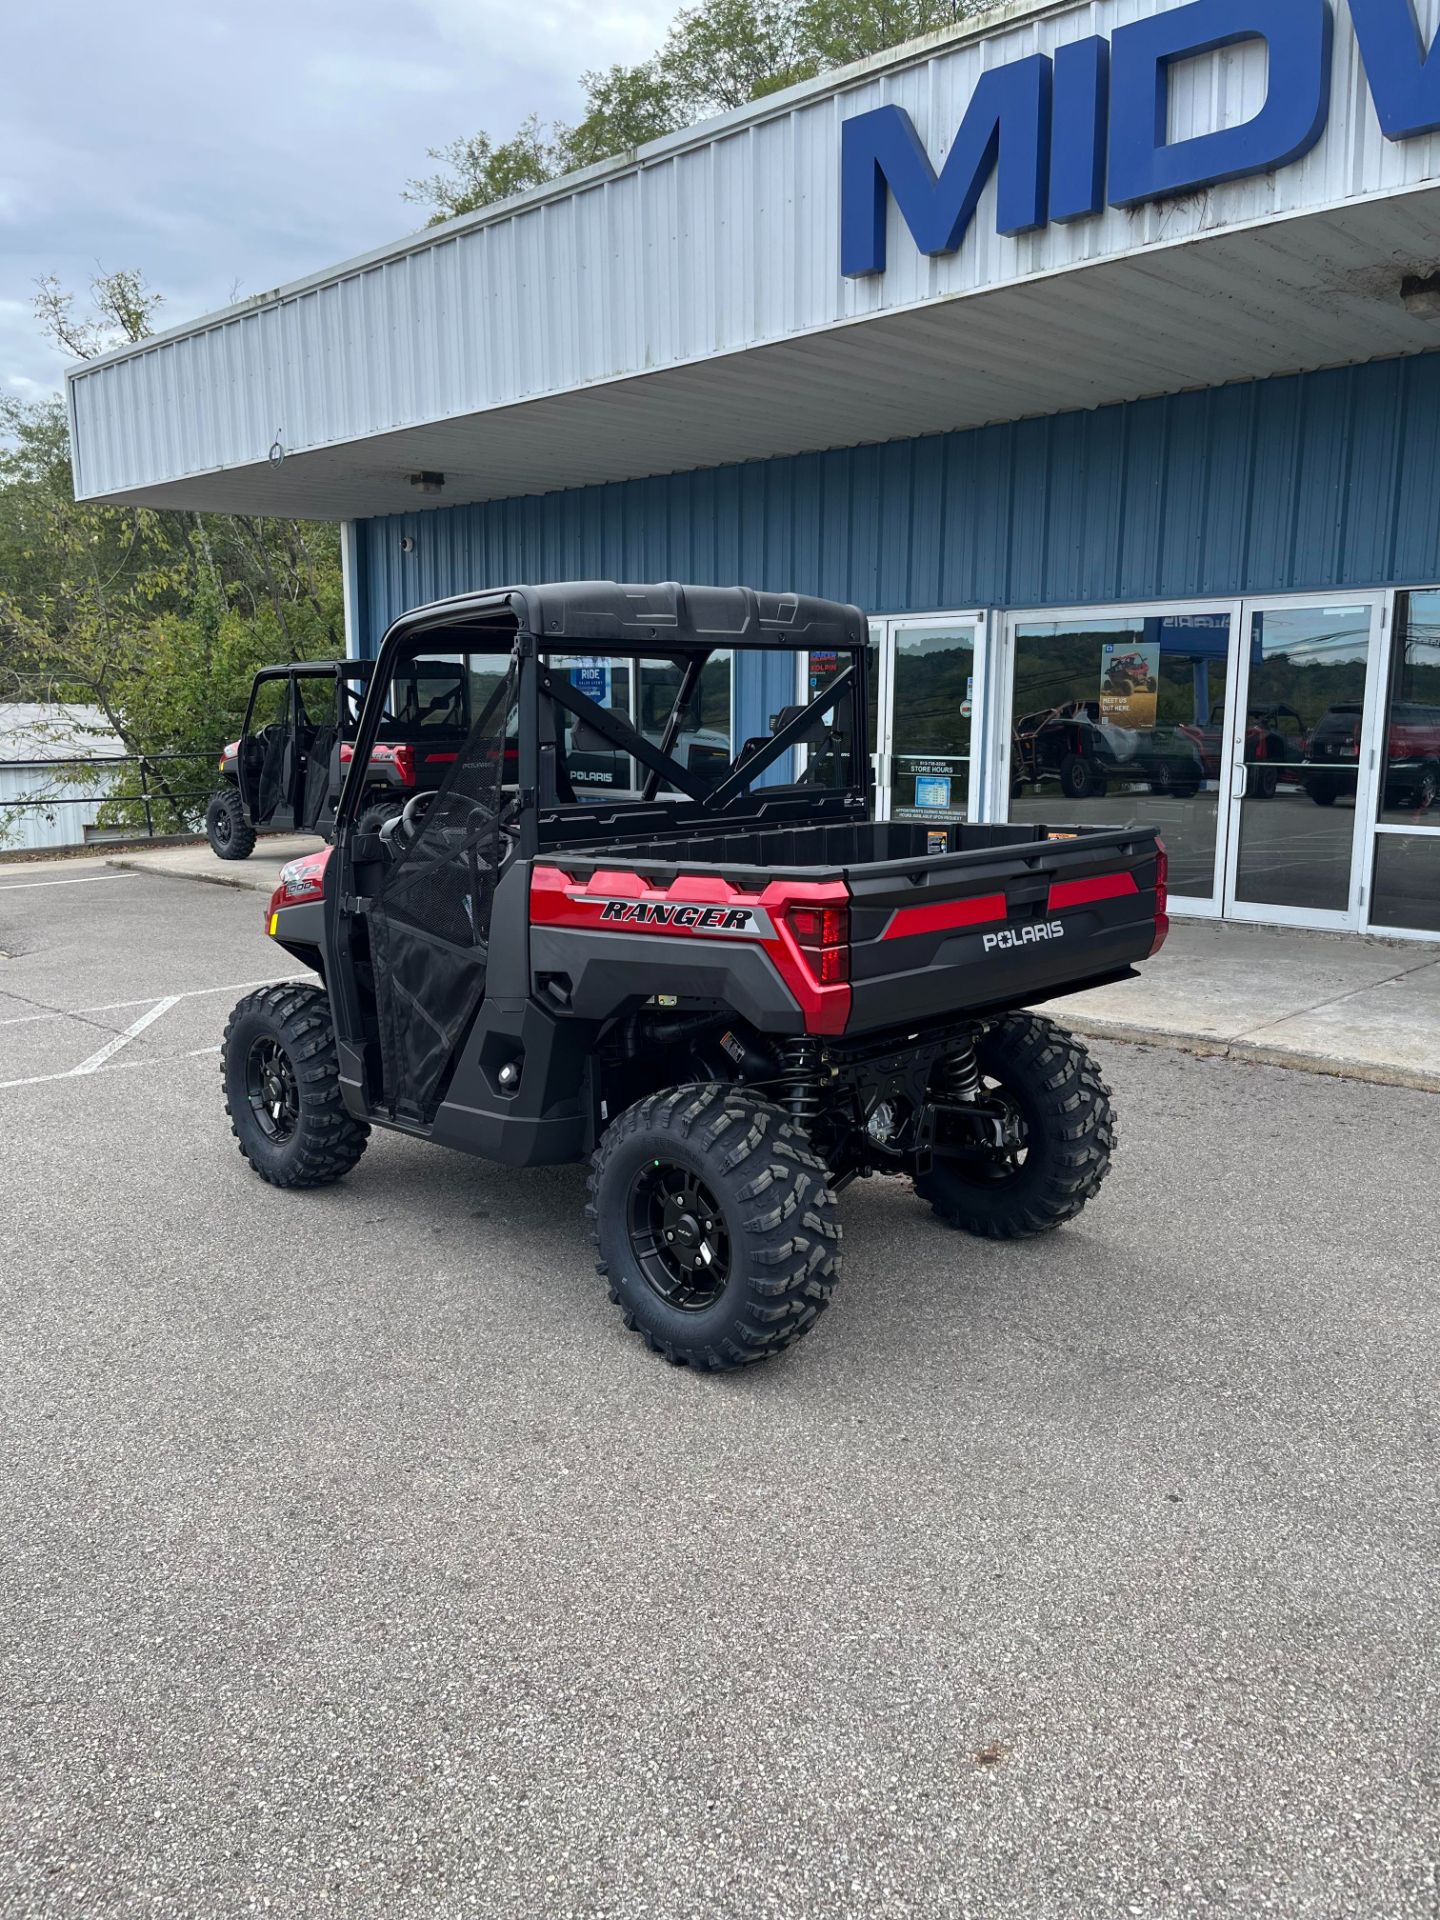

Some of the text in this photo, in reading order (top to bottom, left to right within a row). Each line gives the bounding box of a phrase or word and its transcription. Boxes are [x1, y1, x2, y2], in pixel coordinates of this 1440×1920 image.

[581, 669, 600, 680] RIDE
[570, 771, 613, 782] POLARIS
[600, 901, 753, 930] RANGER
[983, 921, 1064, 952] POLARIS
